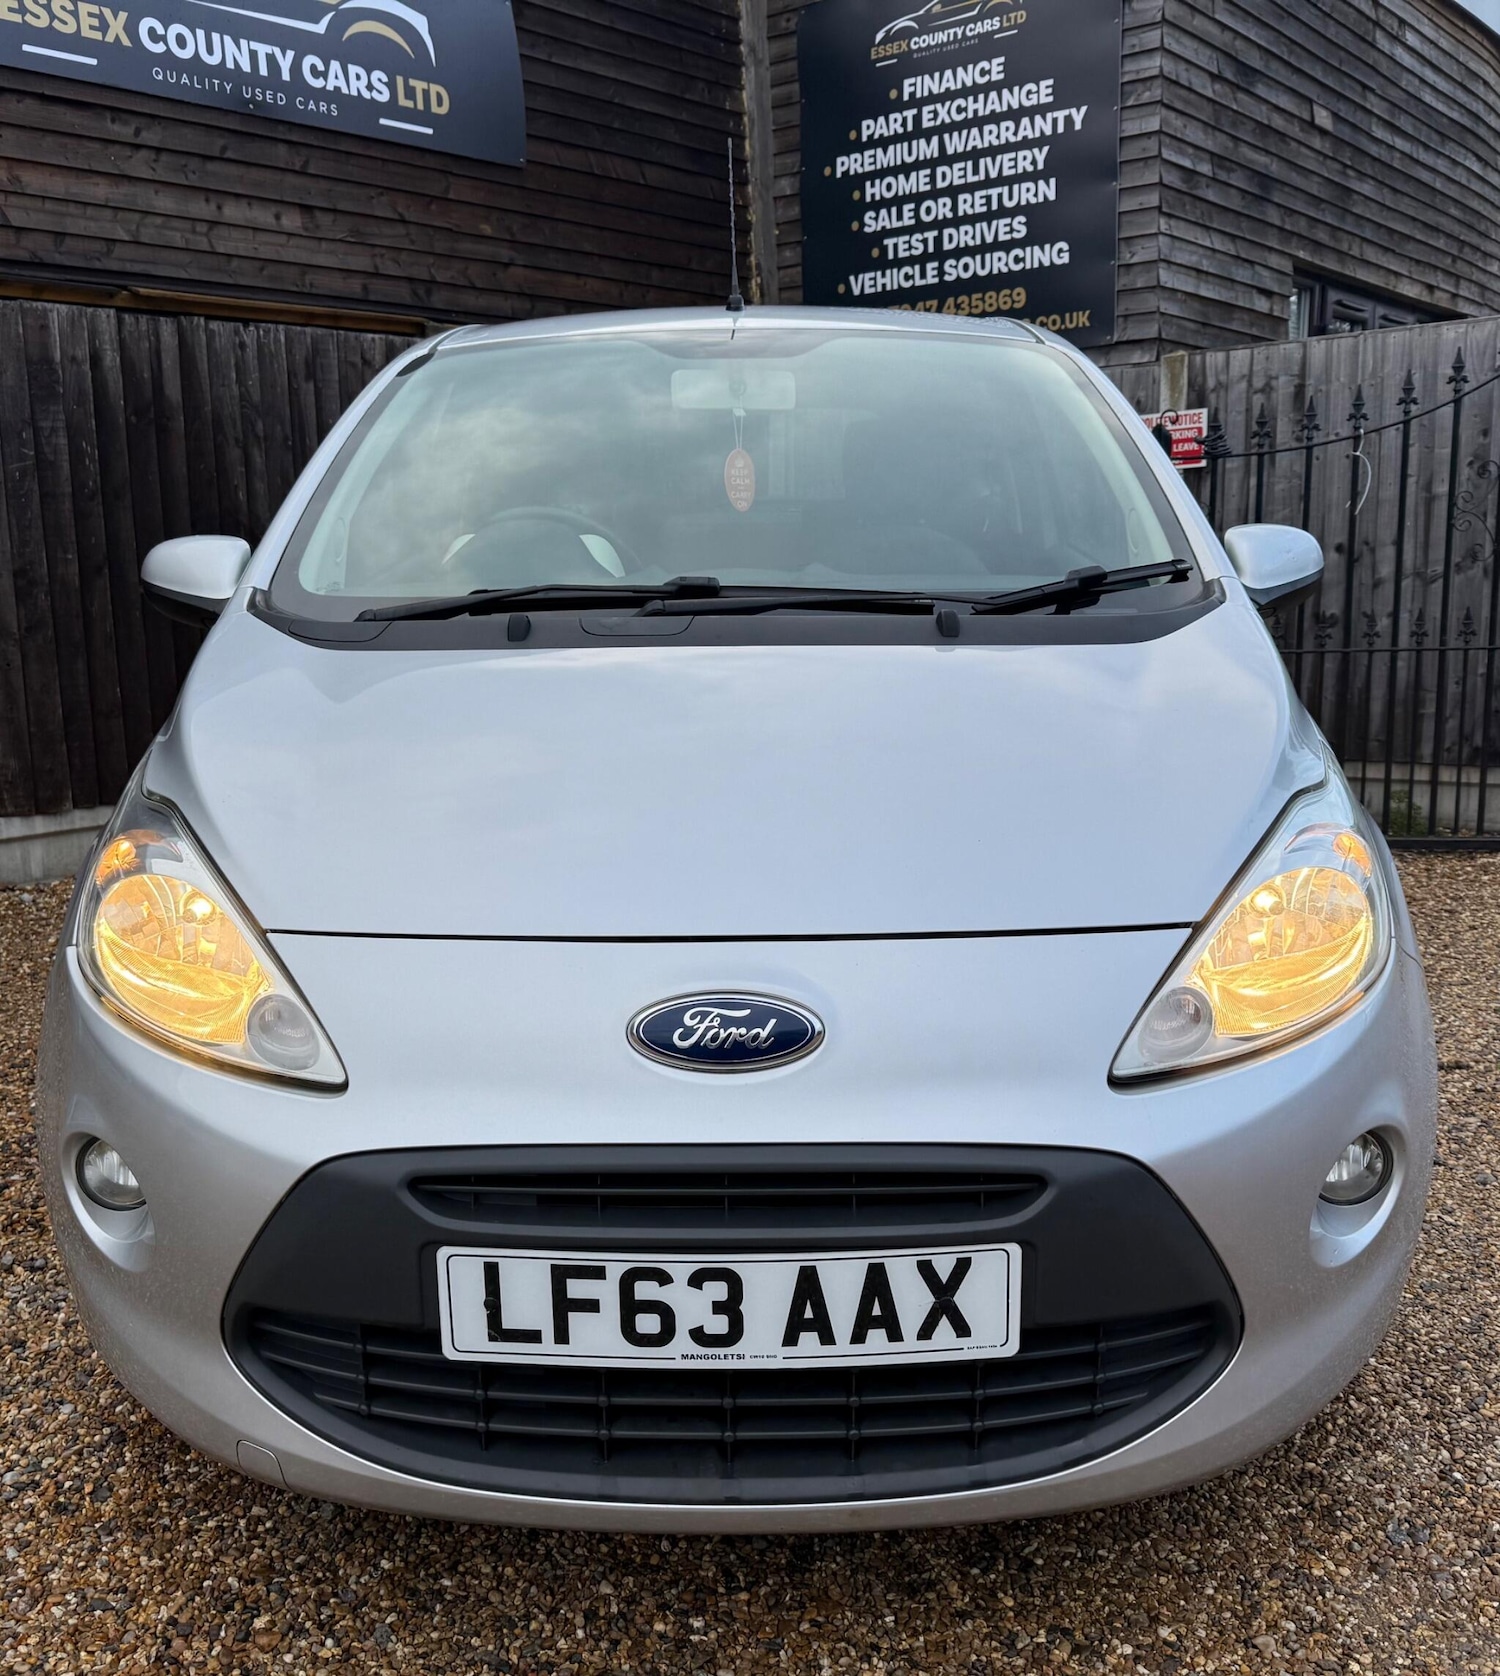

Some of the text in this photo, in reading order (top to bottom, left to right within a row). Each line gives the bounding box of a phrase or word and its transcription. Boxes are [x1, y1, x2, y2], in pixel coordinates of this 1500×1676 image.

[0, 0, 450, 115] ESSEX COUNTY CARS LTD
[870, 10, 1027, 60] ESSEX COUNTY CARS LTD
[152, 67, 338, 116] QUALITY USED CARS
[902, 56, 1006, 101] FINANCE
[861, 78, 1055, 142] PART EXCHANGE
[835, 105, 1089, 178] PREMIUM WARRANTY
[865, 145, 1050, 202] HOME DELIVERY
[863, 177, 1057, 234] SALE OR RETURN
[883, 215, 1028, 260] TEST DRIVES
[849, 241, 1070, 297] VEHICLE SOURCING
[942, 287, 1027, 316] 435869
[673, 1007, 777, 1049] Ford
[483, 1257, 972, 1348] LF63 AAX
[681, 1353, 745, 1361] MANGOLETSI
